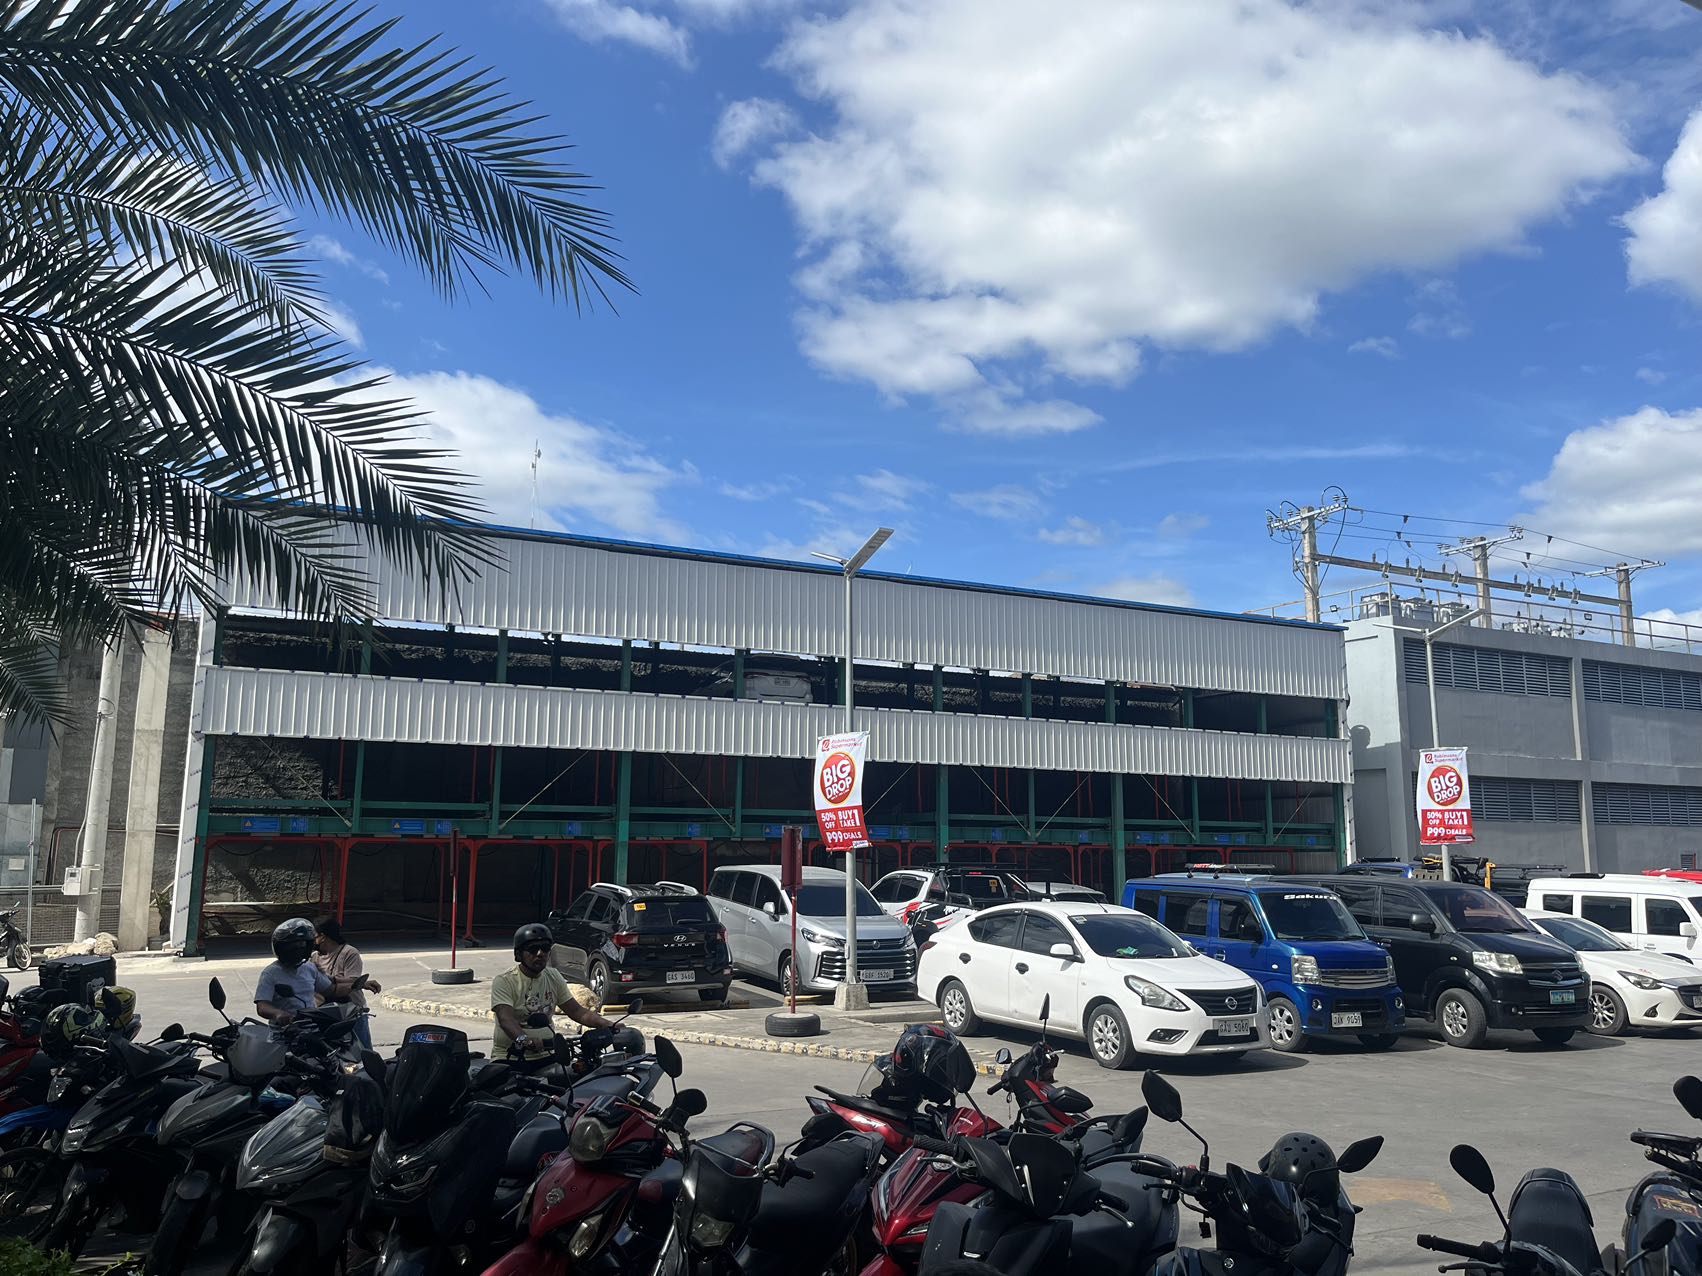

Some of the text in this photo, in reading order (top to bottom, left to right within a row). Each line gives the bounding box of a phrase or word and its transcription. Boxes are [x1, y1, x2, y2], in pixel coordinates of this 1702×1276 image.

[823, 759, 851, 788] BIG
[825, 776, 852, 799] DROP
[1430, 771, 1457, 793] BIG
[1433, 785, 1460, 802] DROP
[821, 811, 836, 822] 50%
[838, 809, 860, 826] BUY 1
[1426, 811, 1442, 819] 50%
[1444, 811, 1468, 825] BUY 1
[825, 821, 835, 829] OFF
[839, 819, 856, 827] TAKE
[842, 832, 862, 840] DEALS
